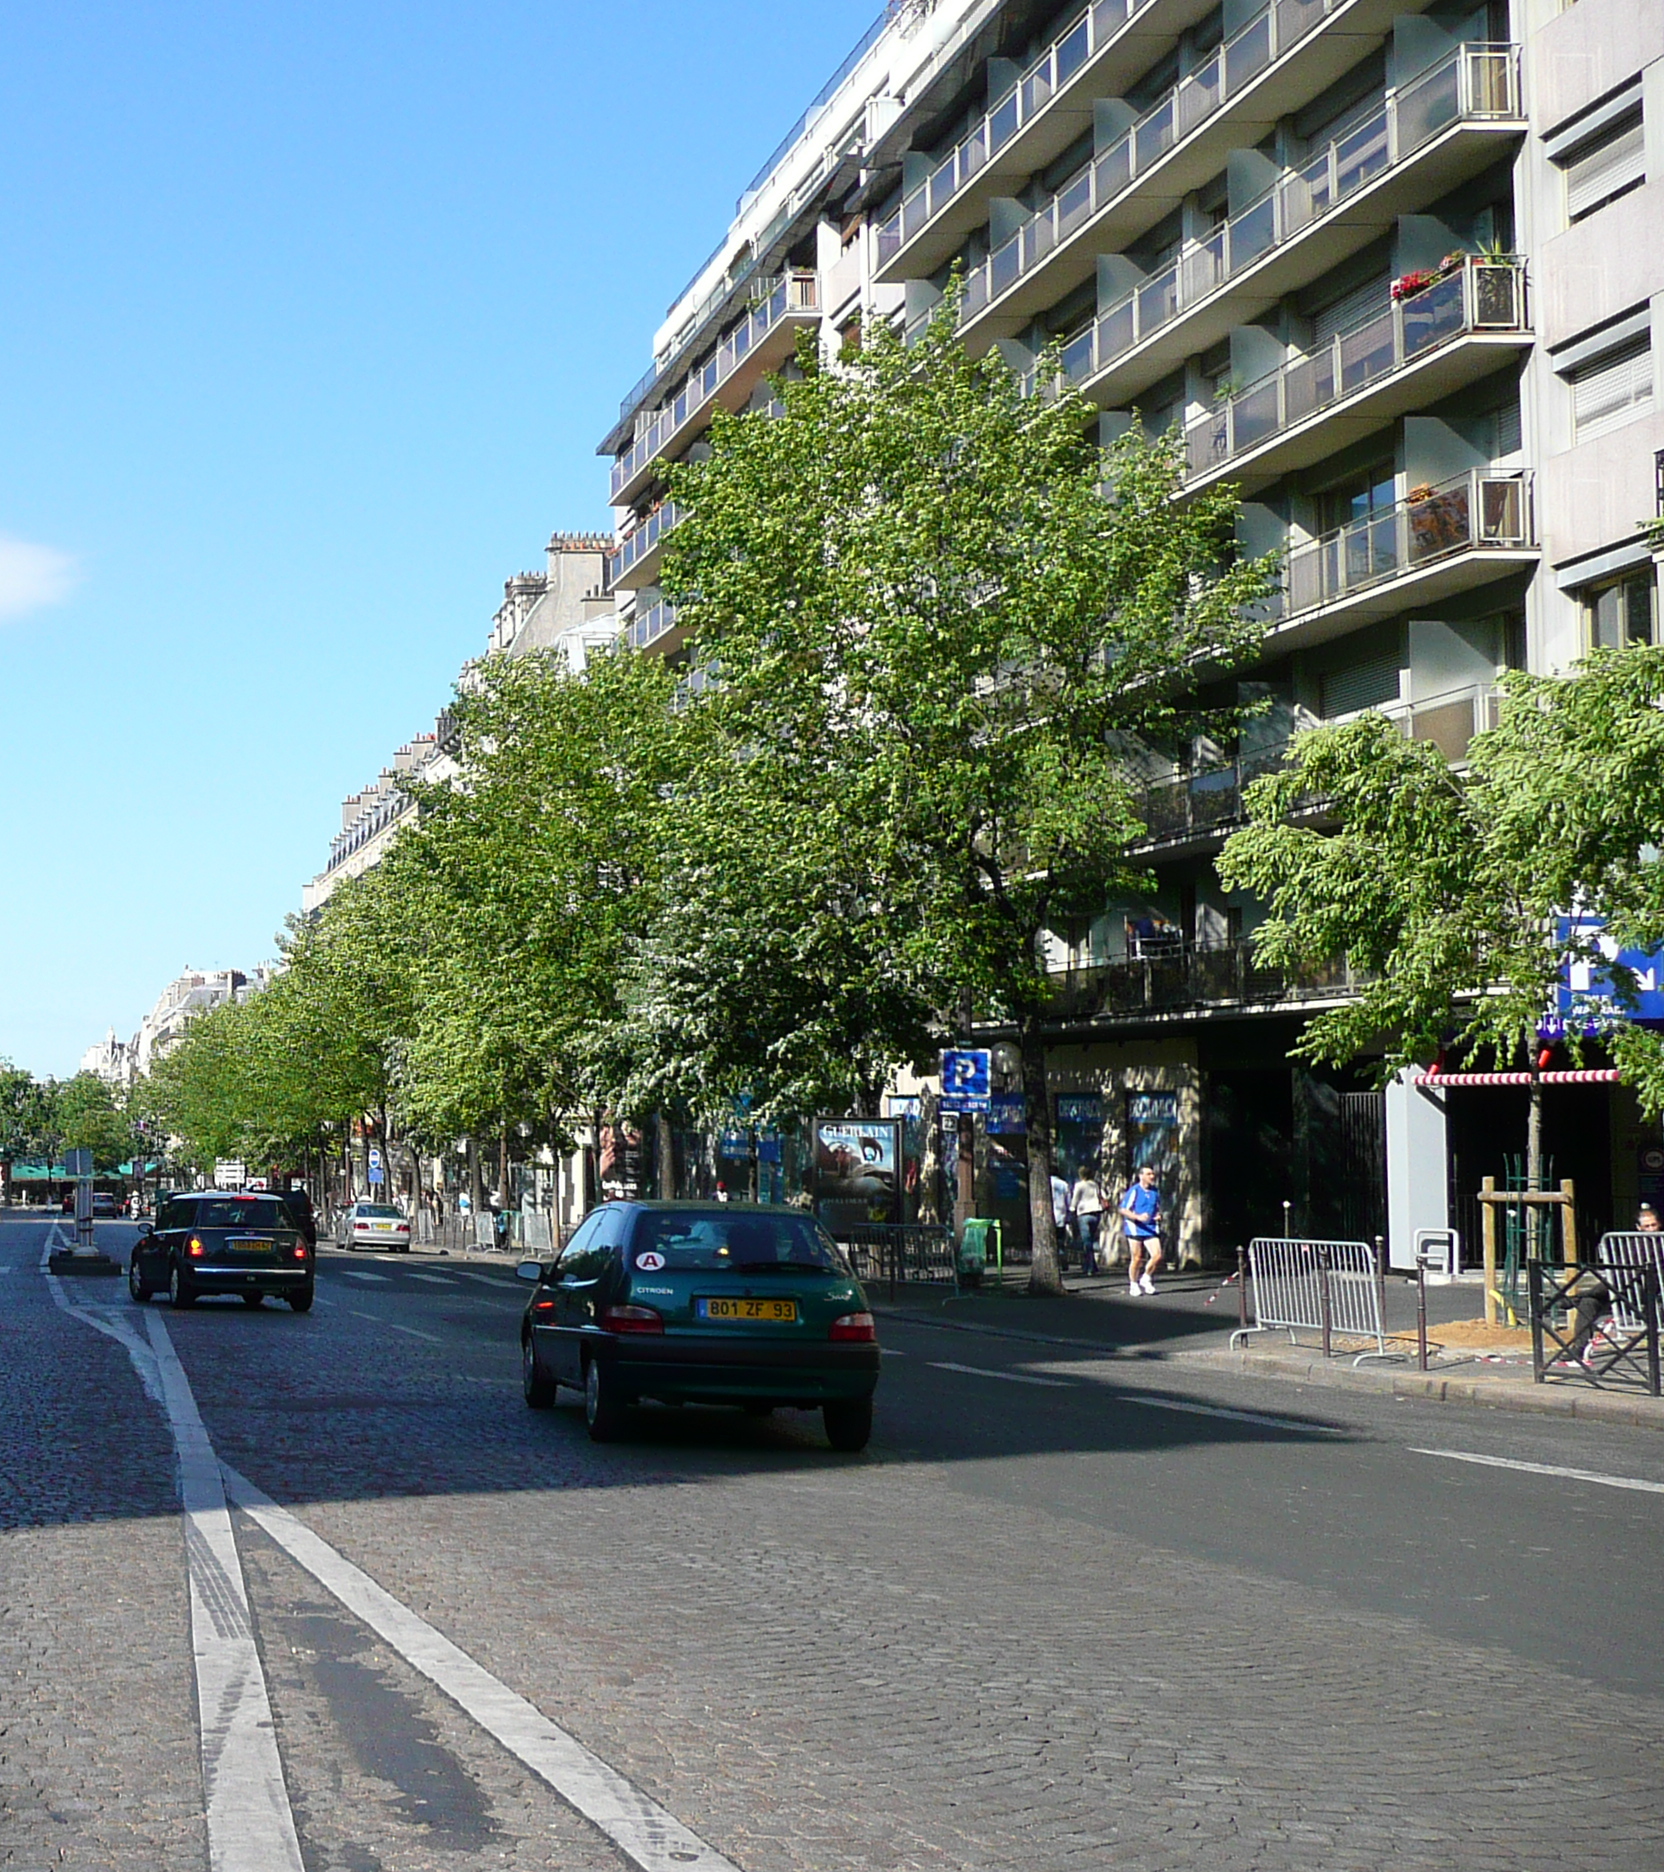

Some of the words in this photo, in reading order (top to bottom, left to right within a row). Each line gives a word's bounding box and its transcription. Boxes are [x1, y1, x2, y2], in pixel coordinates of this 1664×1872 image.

[1569, 925, 1620, 990] P
[954, 1058, 976, 1087] P
[822, 1125, 889, 1138] GUERLAIN
[642, 1255, 659, 1268] A
[710, 1301, 737, 1316] 801
[746, 1302, 763, 1317] ZF
[774, 1303, 793, 1318] 93
